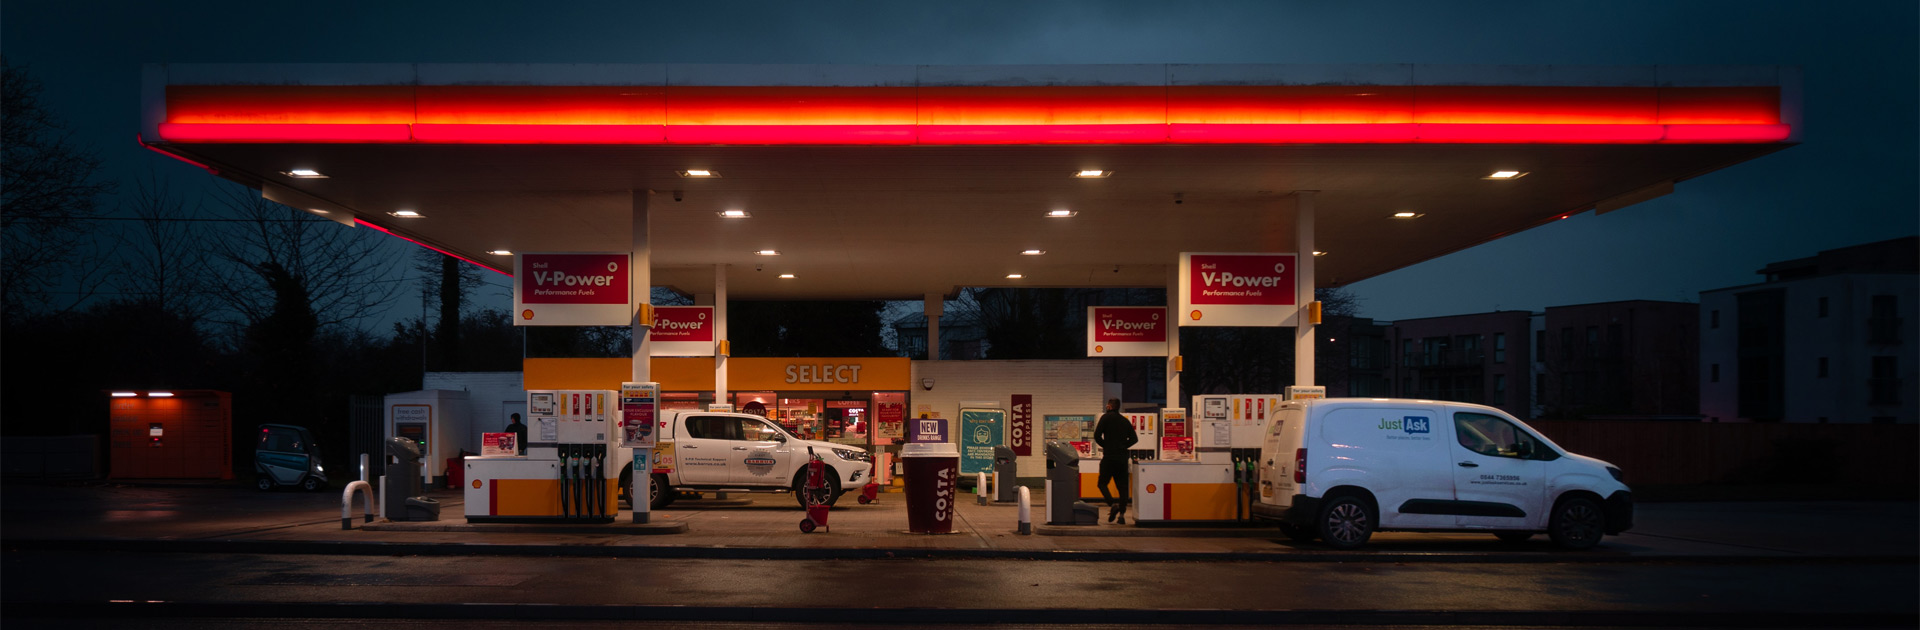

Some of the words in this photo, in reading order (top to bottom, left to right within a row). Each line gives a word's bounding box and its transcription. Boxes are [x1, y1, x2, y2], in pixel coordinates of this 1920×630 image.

[533, 270, 614, 286] V-Power
[1202, 272, 1281, 288] V-Power
[1102, 319, 1157, 330] V-Power
[785, 364, 861, 383] SELECT
[921, 422, 937, 433] NEW
[1012, 404, 1024, 447] COSTA
[1378, 418, 1402, 429] Just
[1406, 418, 1428, 431] Ask
[935, 468, 949, 521] COSTA
